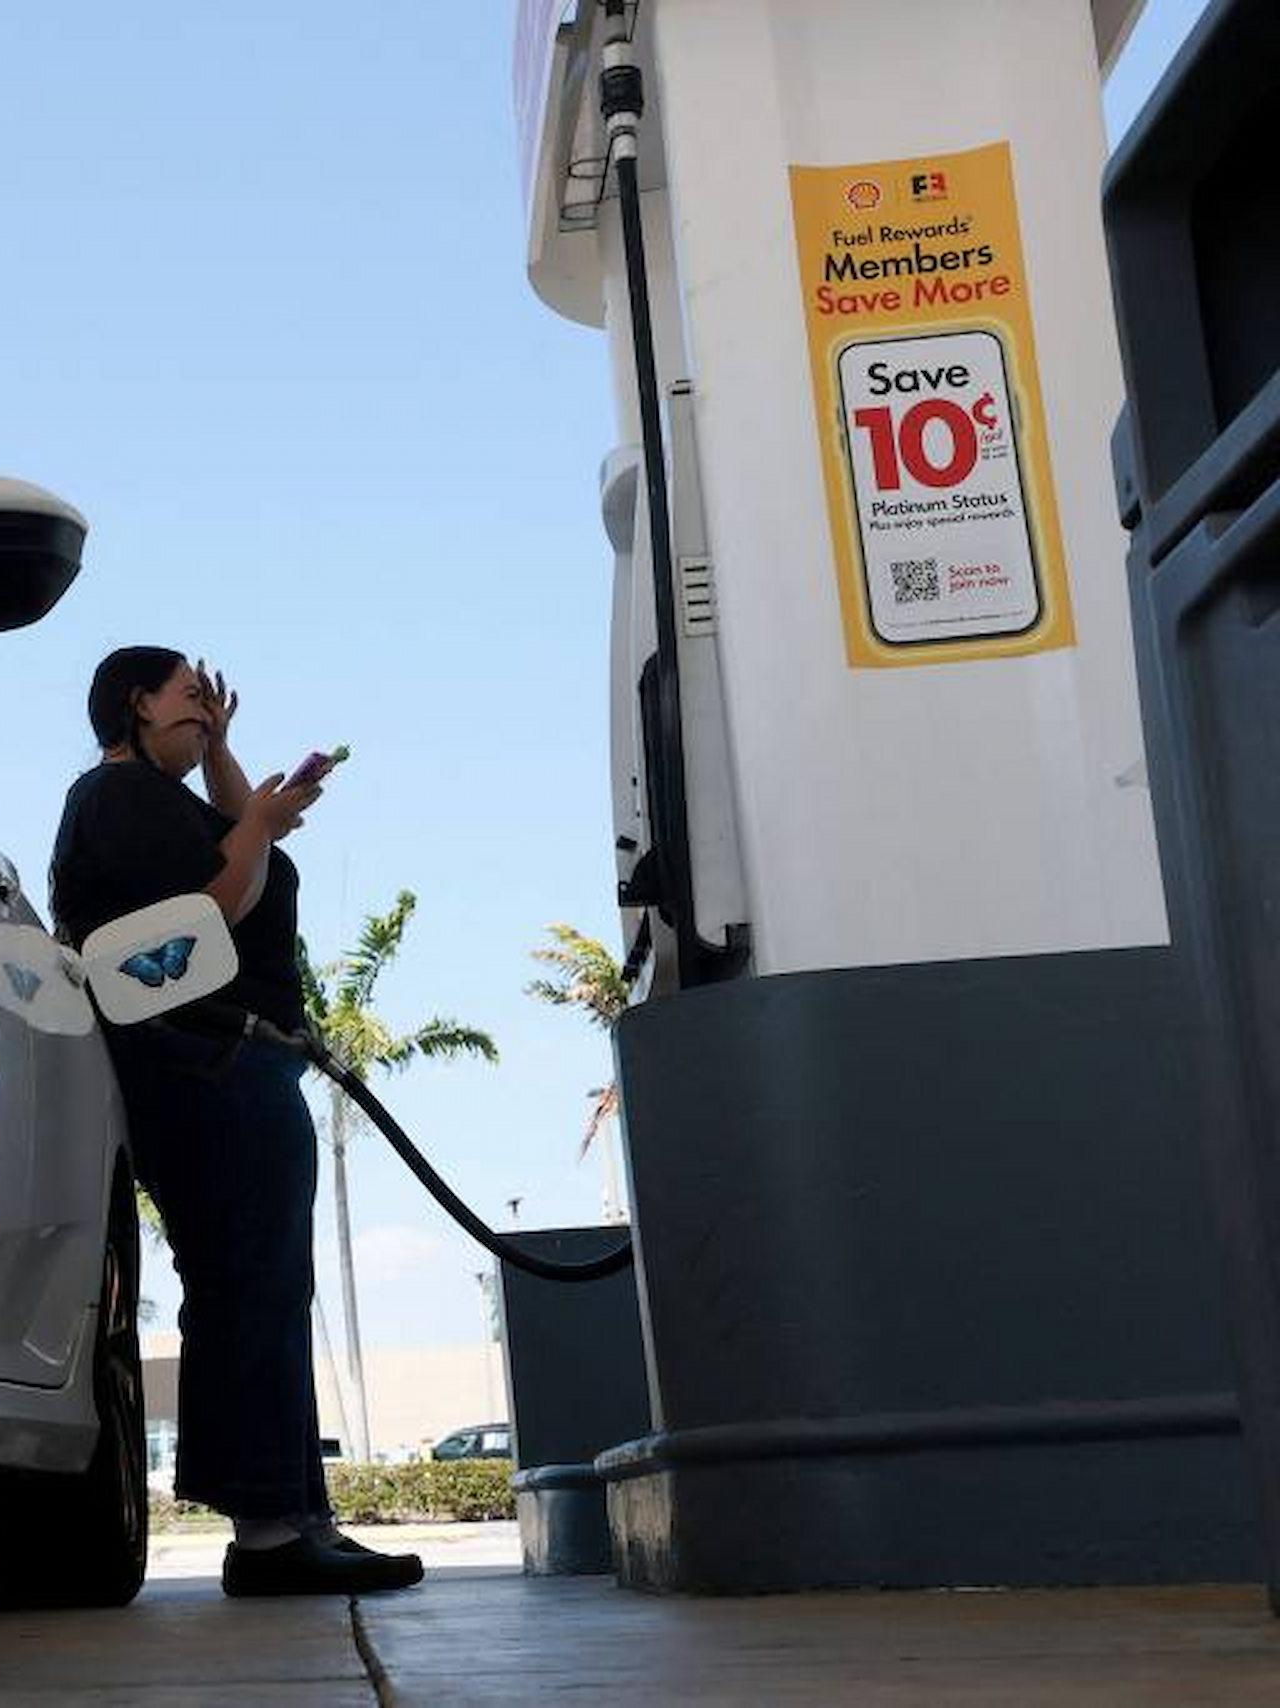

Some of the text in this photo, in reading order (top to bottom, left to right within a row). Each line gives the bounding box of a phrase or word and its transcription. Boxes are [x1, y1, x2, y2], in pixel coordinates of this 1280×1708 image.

[832, 226, 873, 247] Fuel
[825, 243, 993, 282] Members
[816, 275, 1010, 315] Save More
[868, 363, 969, 395] Save
[872, 493, 1008, 517] Platinum Status
[948, 564, 1001, 577] Scan to
